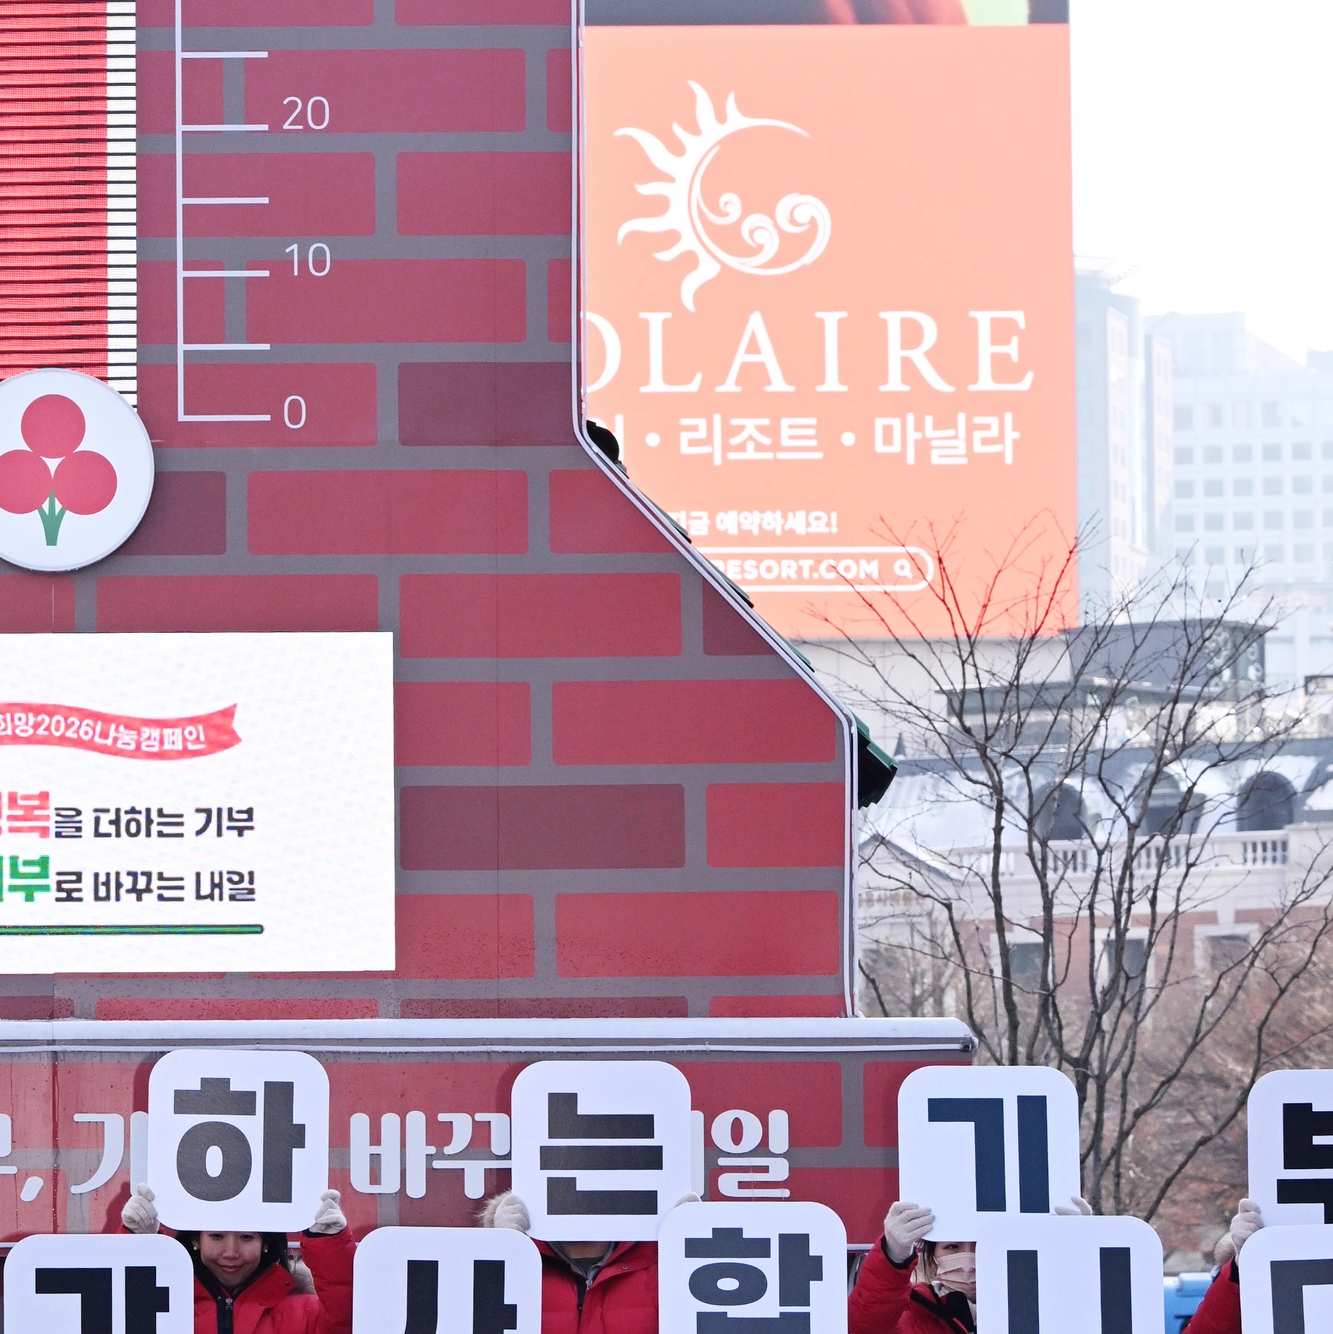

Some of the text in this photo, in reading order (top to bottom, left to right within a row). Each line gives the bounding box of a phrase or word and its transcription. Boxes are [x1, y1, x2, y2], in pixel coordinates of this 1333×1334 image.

[282, 96, 330, 130] 20
[284, 243, 331, 277] 10
[283, 395, 306, 429] 0
[679, 413, 824, 466] 리조트
[874, 412, 1020, 465] 마닐라
[716, 510, 838, 536] 예약하세요!
[93, 807, 185, 839] 더하는
[194, 807, 255, 839] 기부
[93, 870, 185, 903] 바꾸는
[194, 870, 256, 903] 내일
[174, 1077, 306, 1203] 하
[350, 1110, 512, 1199] 바꾸
[539, 1092, 663, 1216] 는
[928, 1095, 1050, 1213] 기
